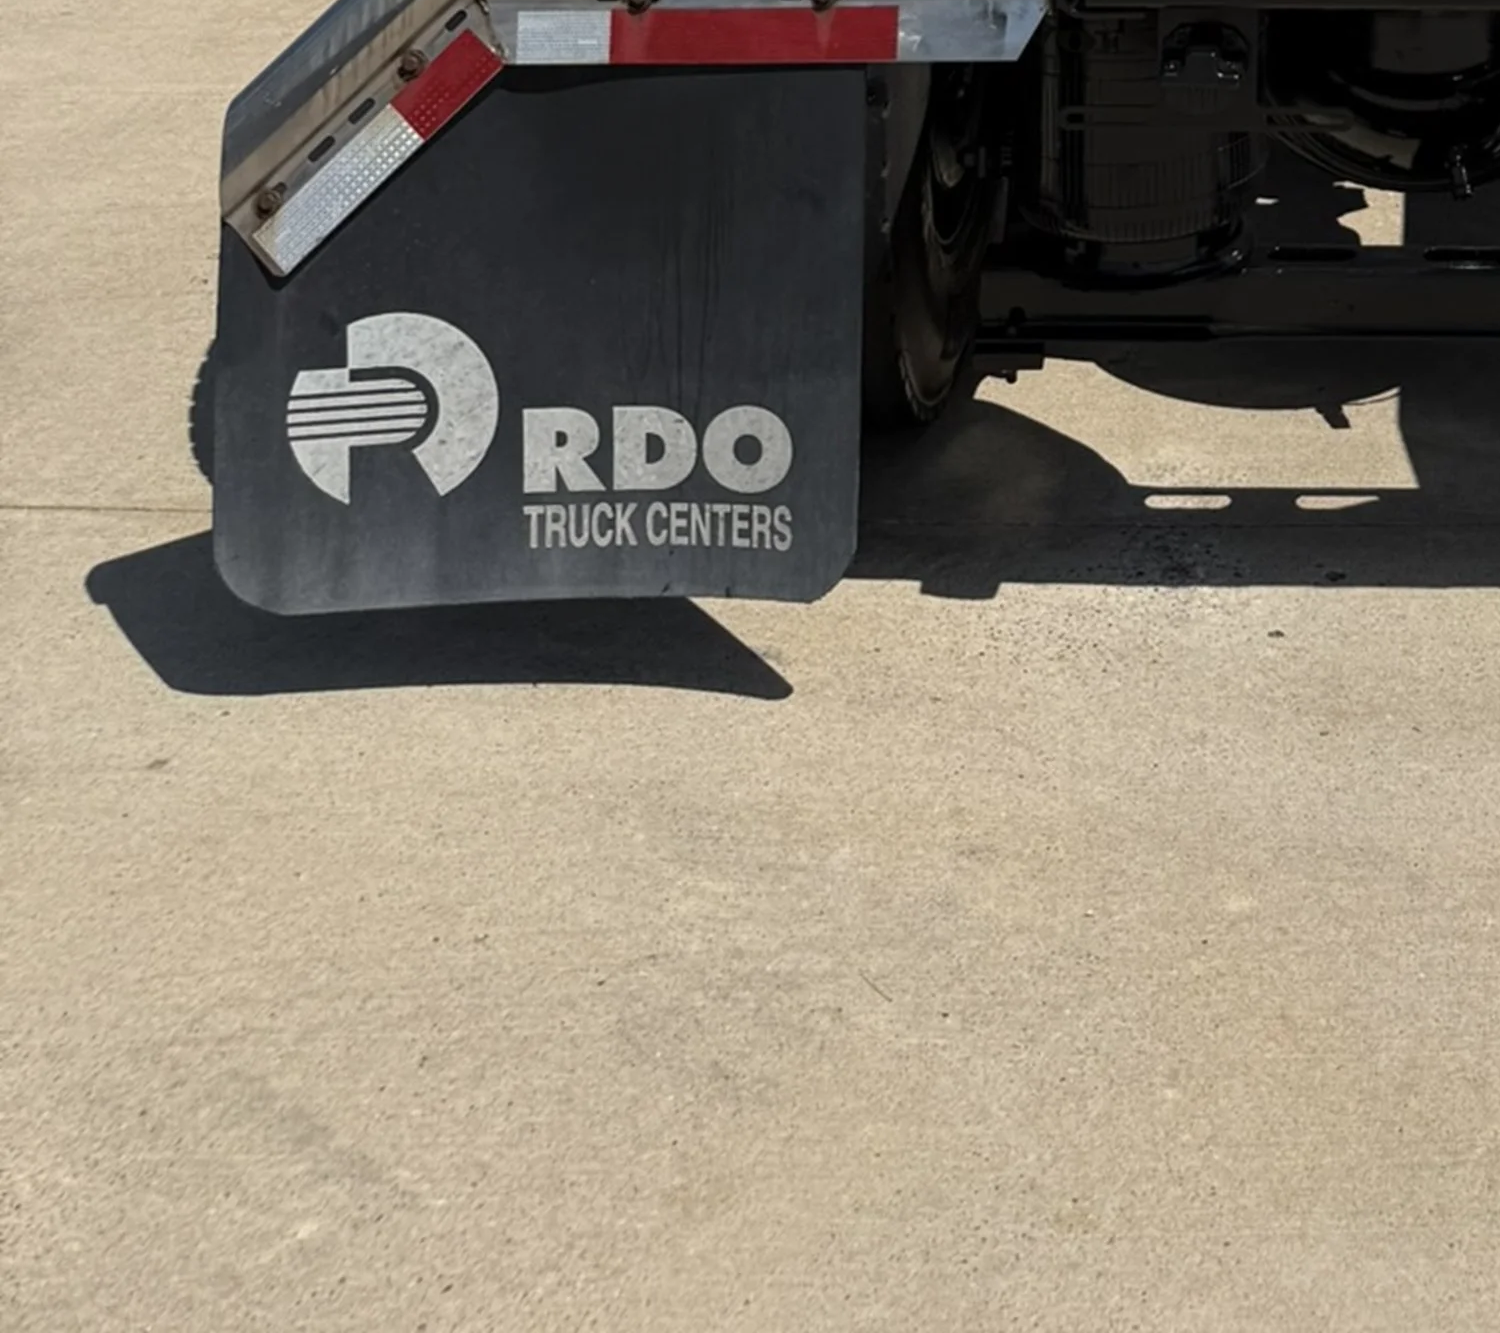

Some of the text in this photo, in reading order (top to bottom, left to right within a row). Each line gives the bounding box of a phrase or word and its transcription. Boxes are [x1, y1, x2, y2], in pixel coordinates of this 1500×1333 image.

[522, 405, 793, 493] RDO
[523, 501, 793, 551] TRUCK CENTERS
